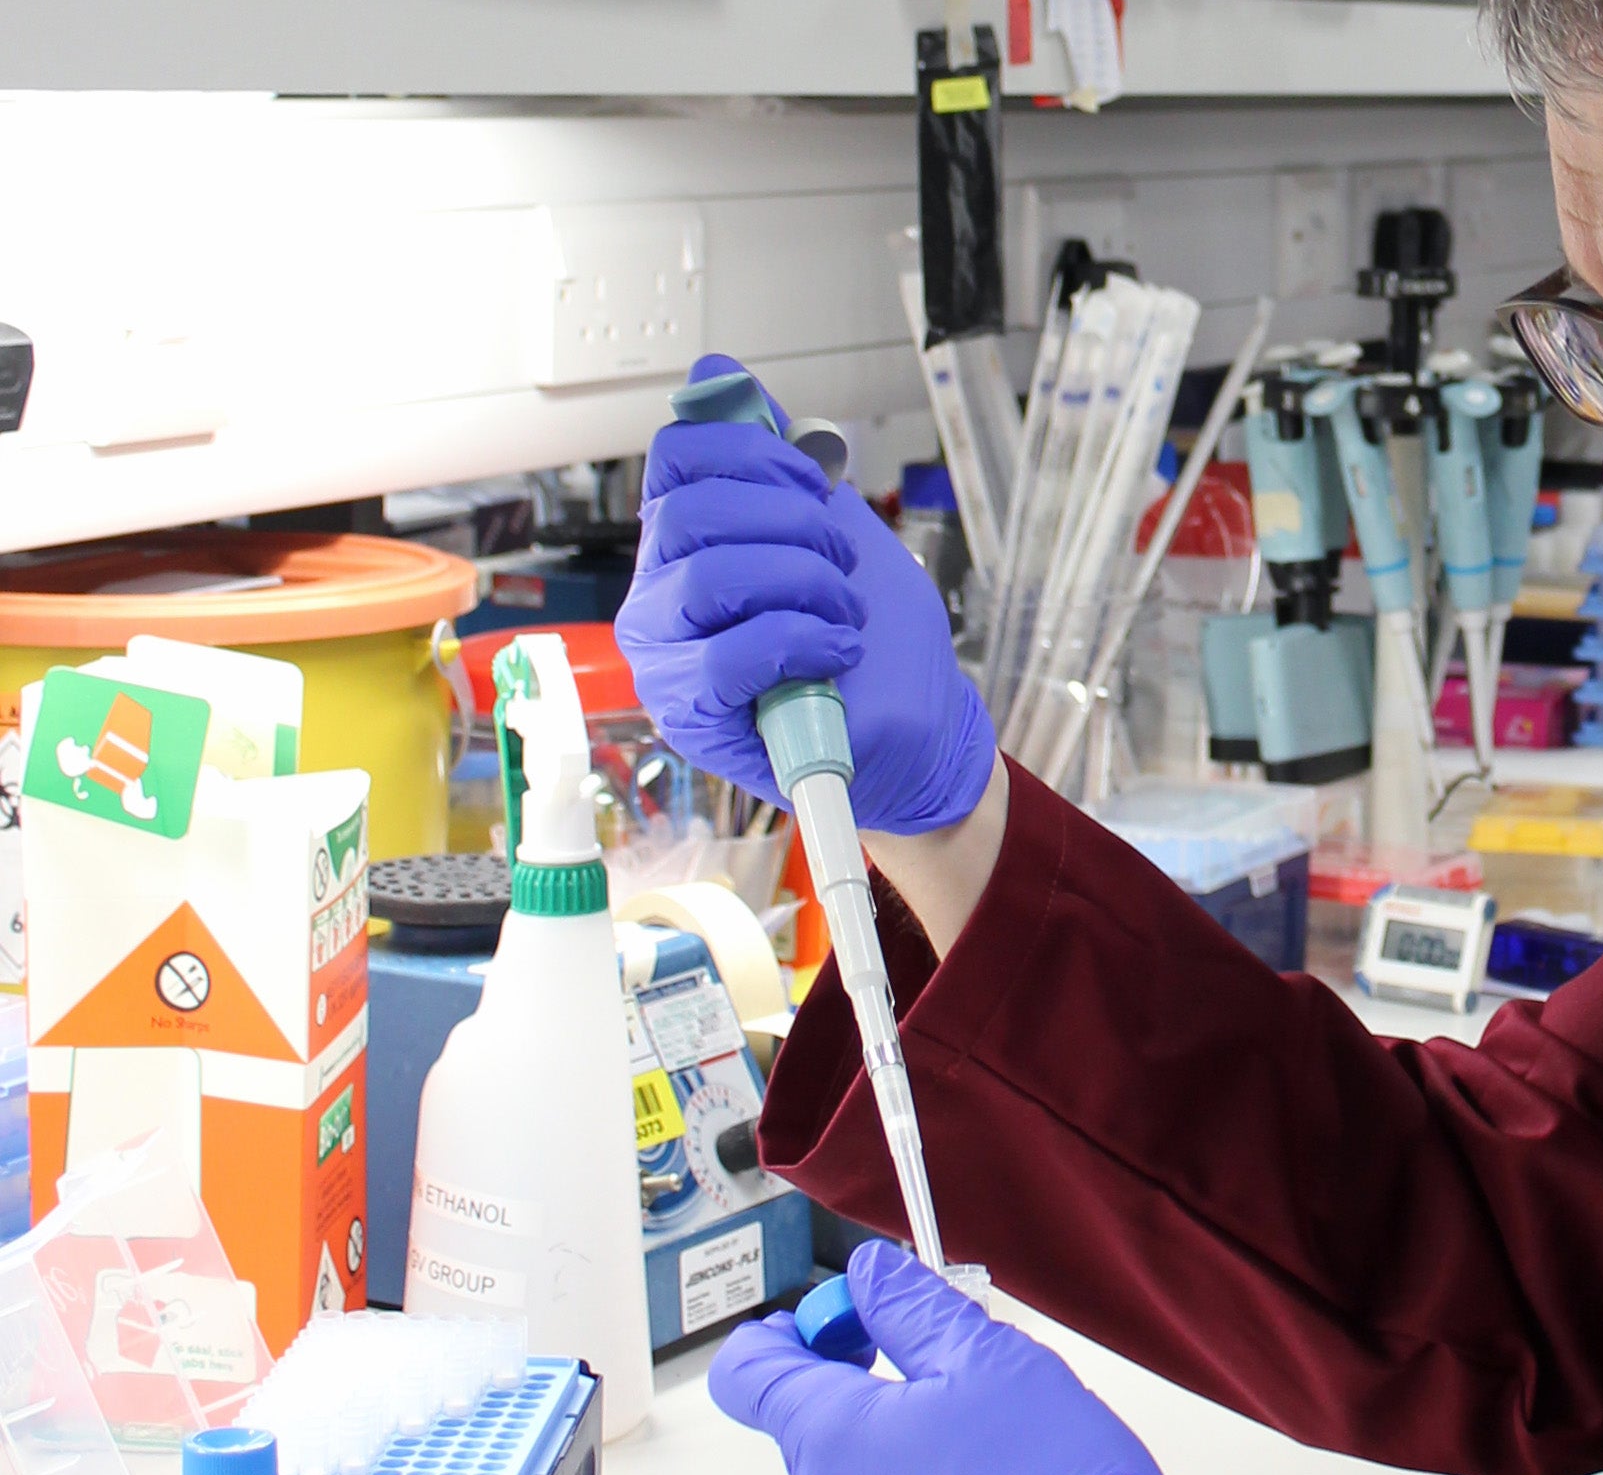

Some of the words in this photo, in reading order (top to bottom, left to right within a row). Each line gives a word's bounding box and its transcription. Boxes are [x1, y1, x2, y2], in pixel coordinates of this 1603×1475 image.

[151, 1016, 172, 1029] No
[175, 1016, 210, 1034] Sharps
[425, 1183, 512, 1228] ETHANOL
[428, 1259, 496, 1294] GROUP
